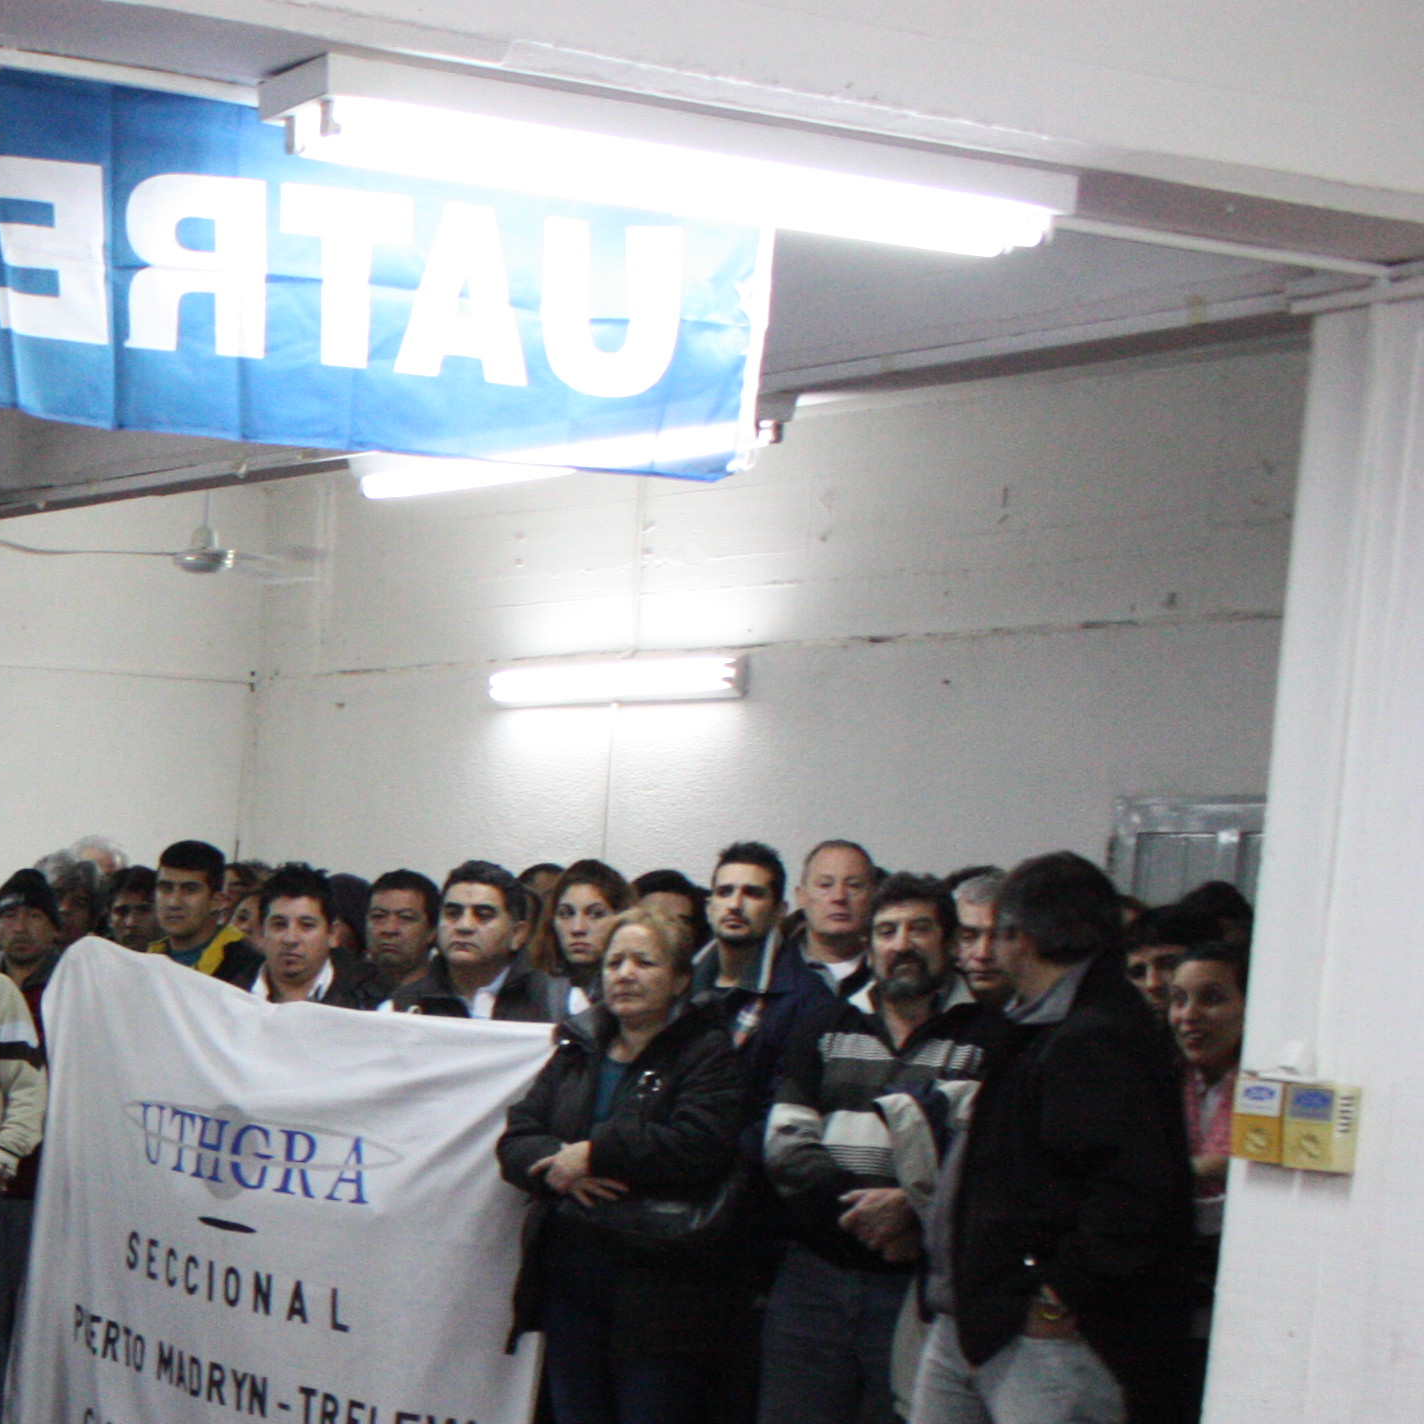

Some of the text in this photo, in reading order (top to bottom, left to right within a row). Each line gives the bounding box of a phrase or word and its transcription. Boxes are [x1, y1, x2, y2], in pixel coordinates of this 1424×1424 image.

[140, 1102, 369, 1205] UTHGRA
[126, 1230, 350, 1333] SECCIONAL
[73, 1303, 146, 1373] PERTO
